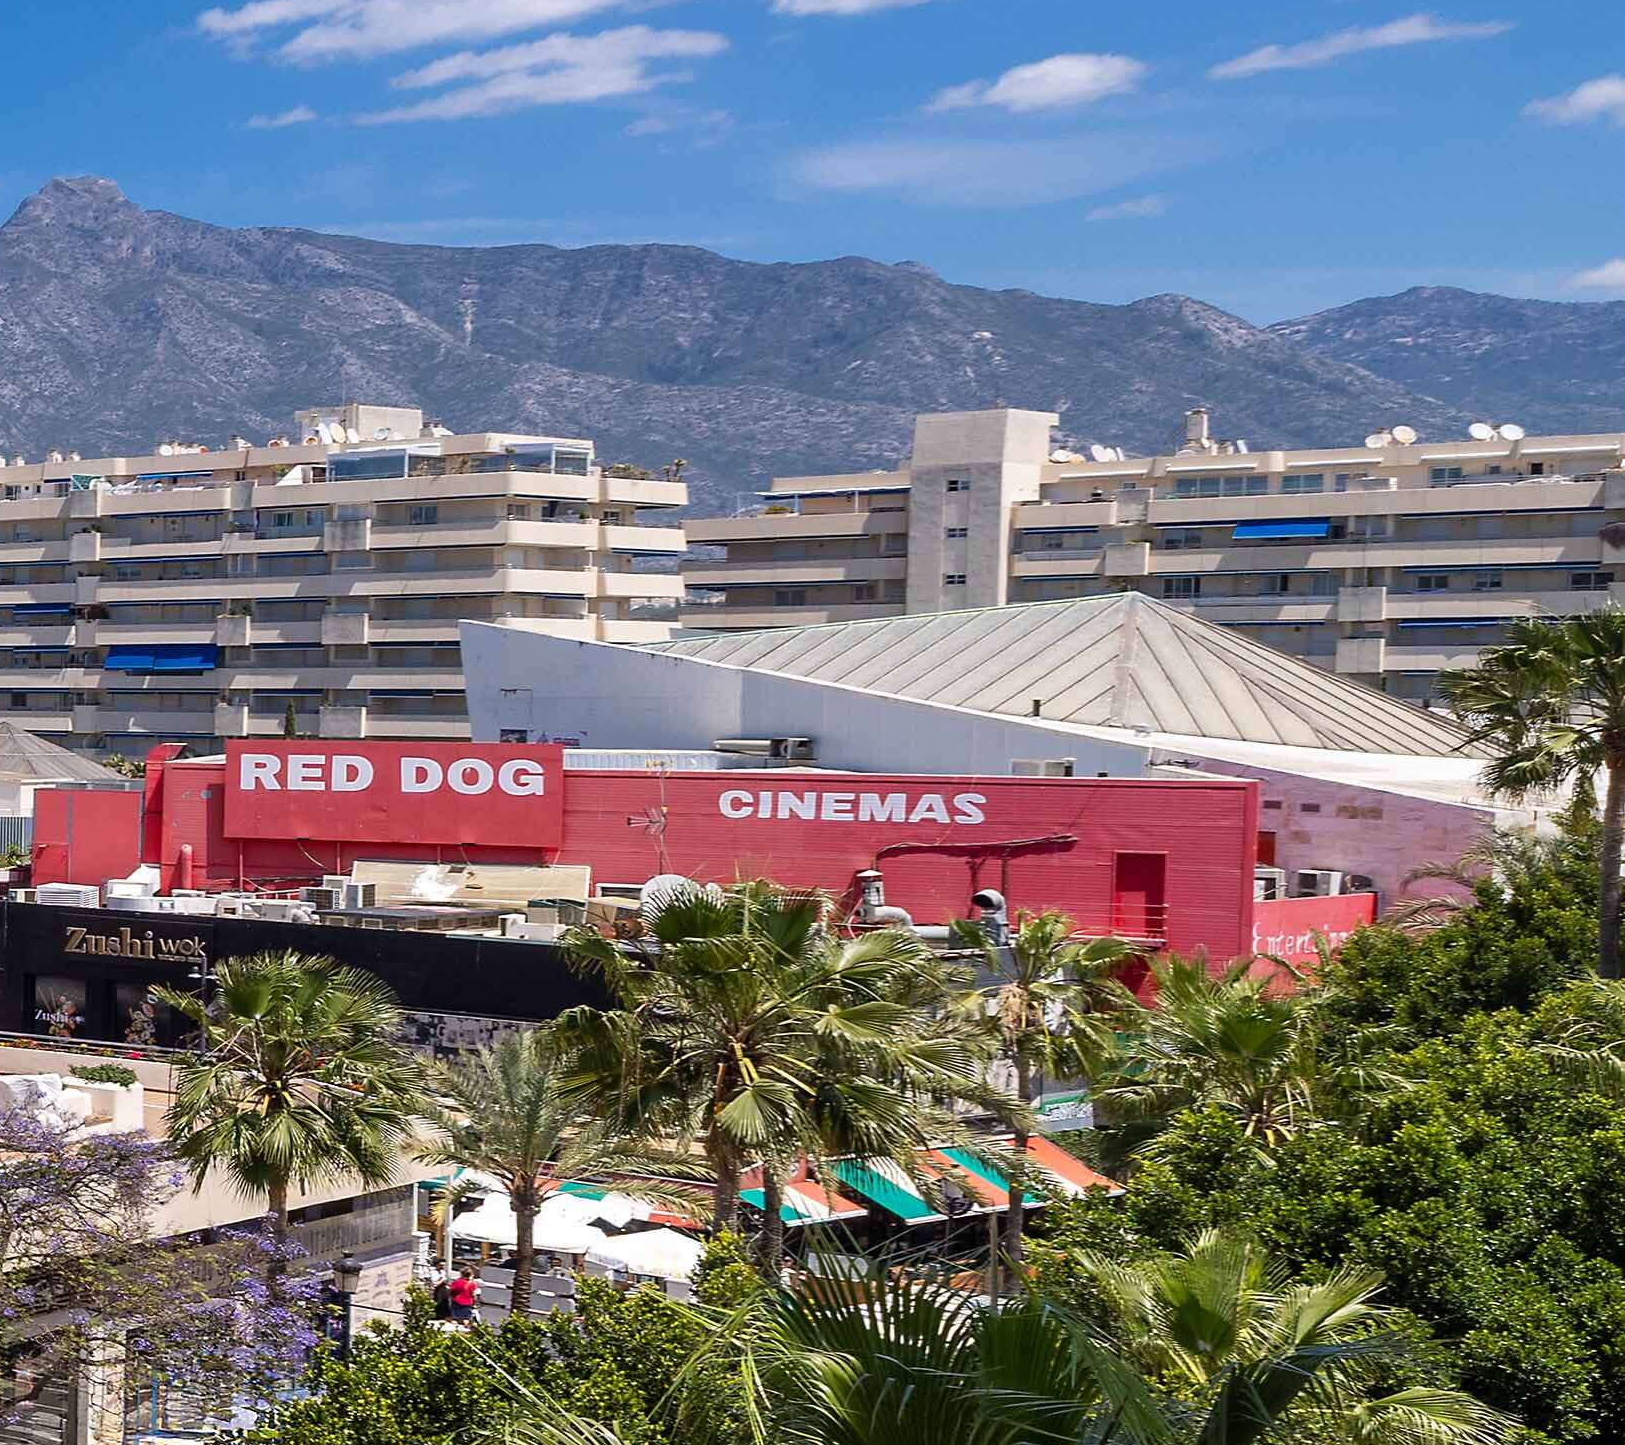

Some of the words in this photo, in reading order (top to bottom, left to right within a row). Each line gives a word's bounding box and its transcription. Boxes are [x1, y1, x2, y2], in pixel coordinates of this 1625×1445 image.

[240, 753, 374, 793] RED
[400, 756, 535, 797] DOG
[717, 790, 988, 825] CINEMAS
[63, 926, 156, 960] Zushi
[158, 935, 206, 957] wok
